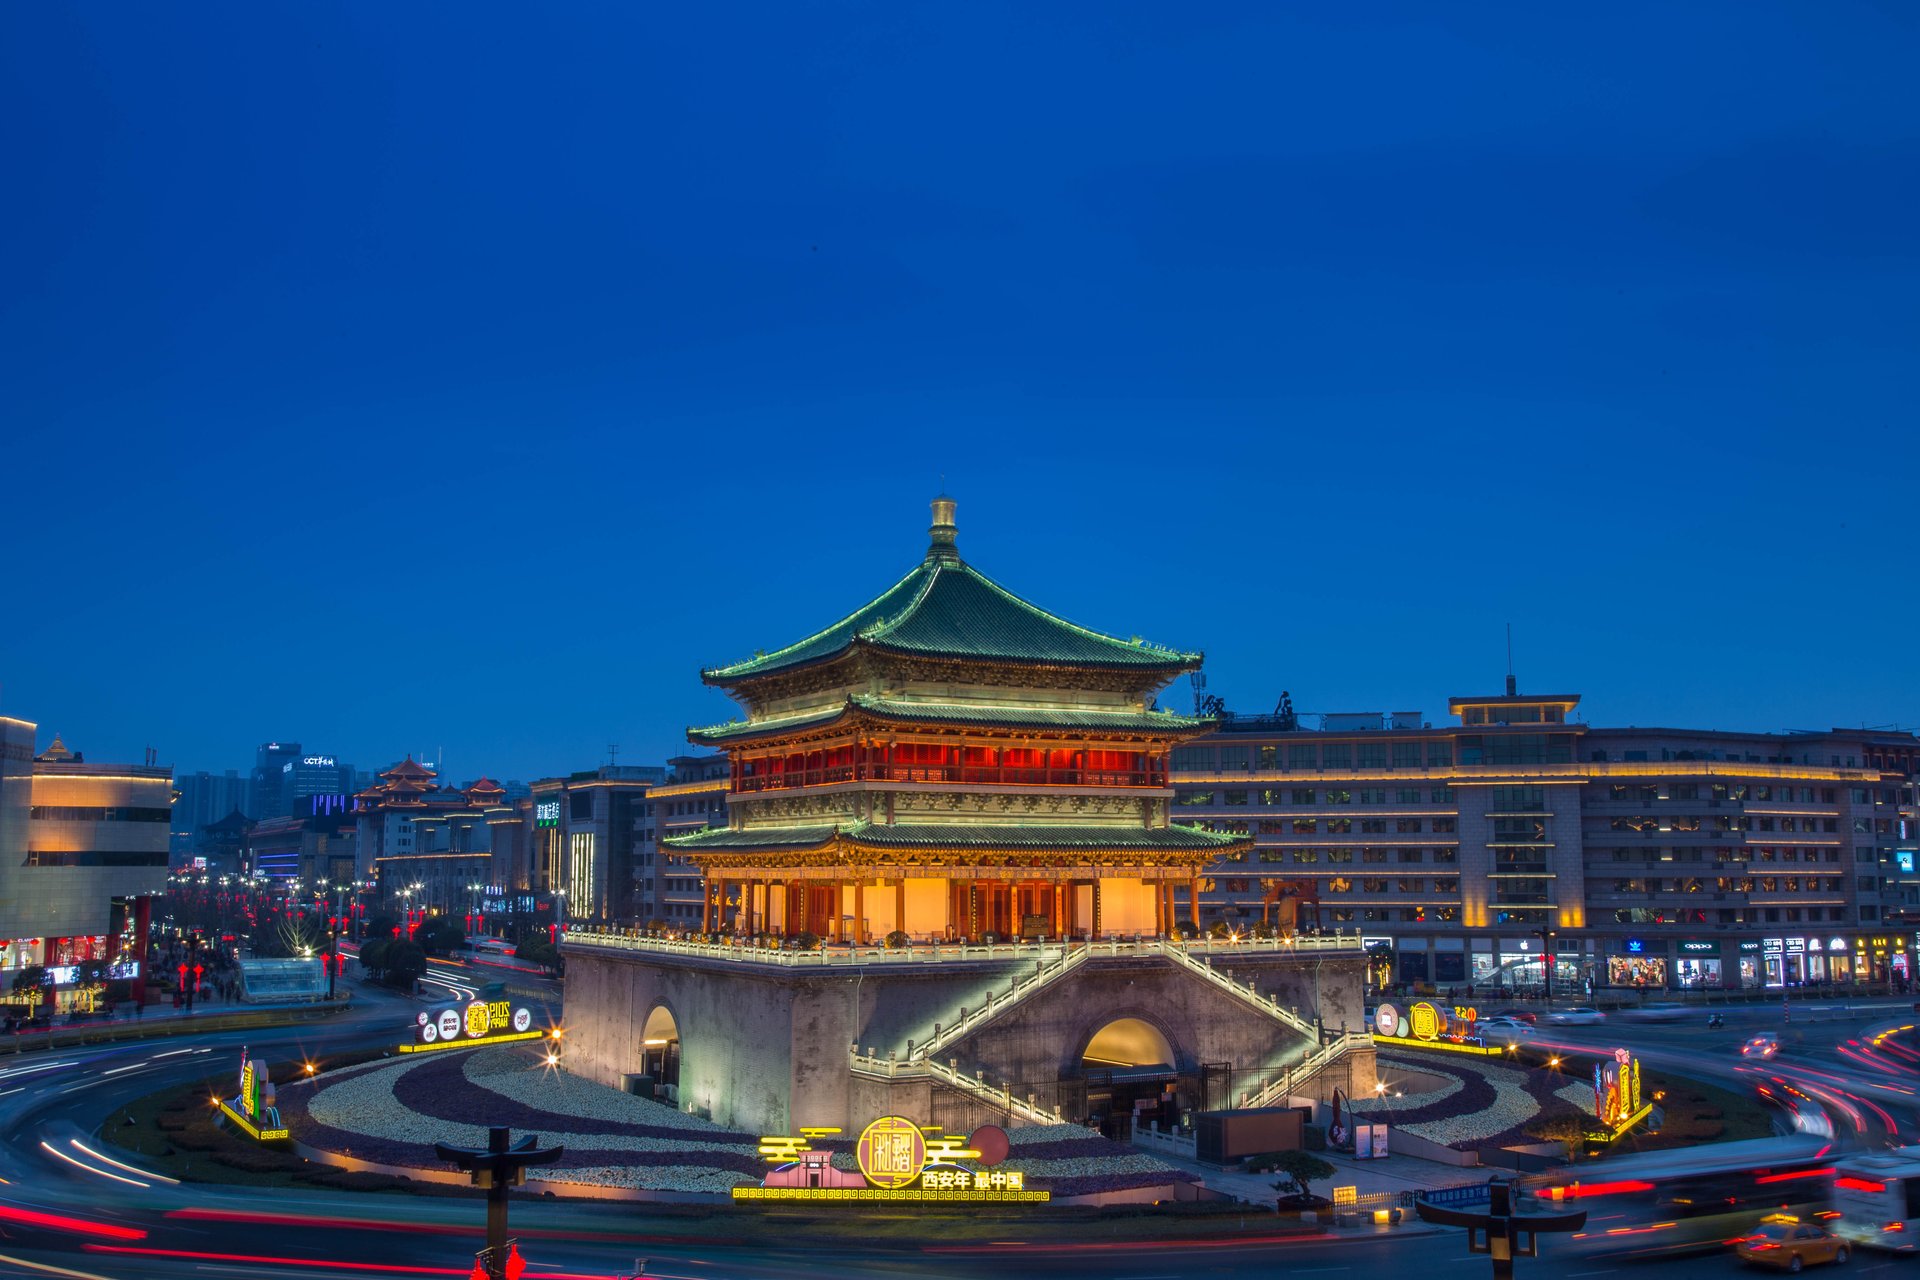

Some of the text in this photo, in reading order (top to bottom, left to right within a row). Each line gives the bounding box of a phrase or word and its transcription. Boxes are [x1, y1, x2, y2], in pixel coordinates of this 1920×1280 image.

[922, 1171, 1023, 1190] 西安年 最中国
